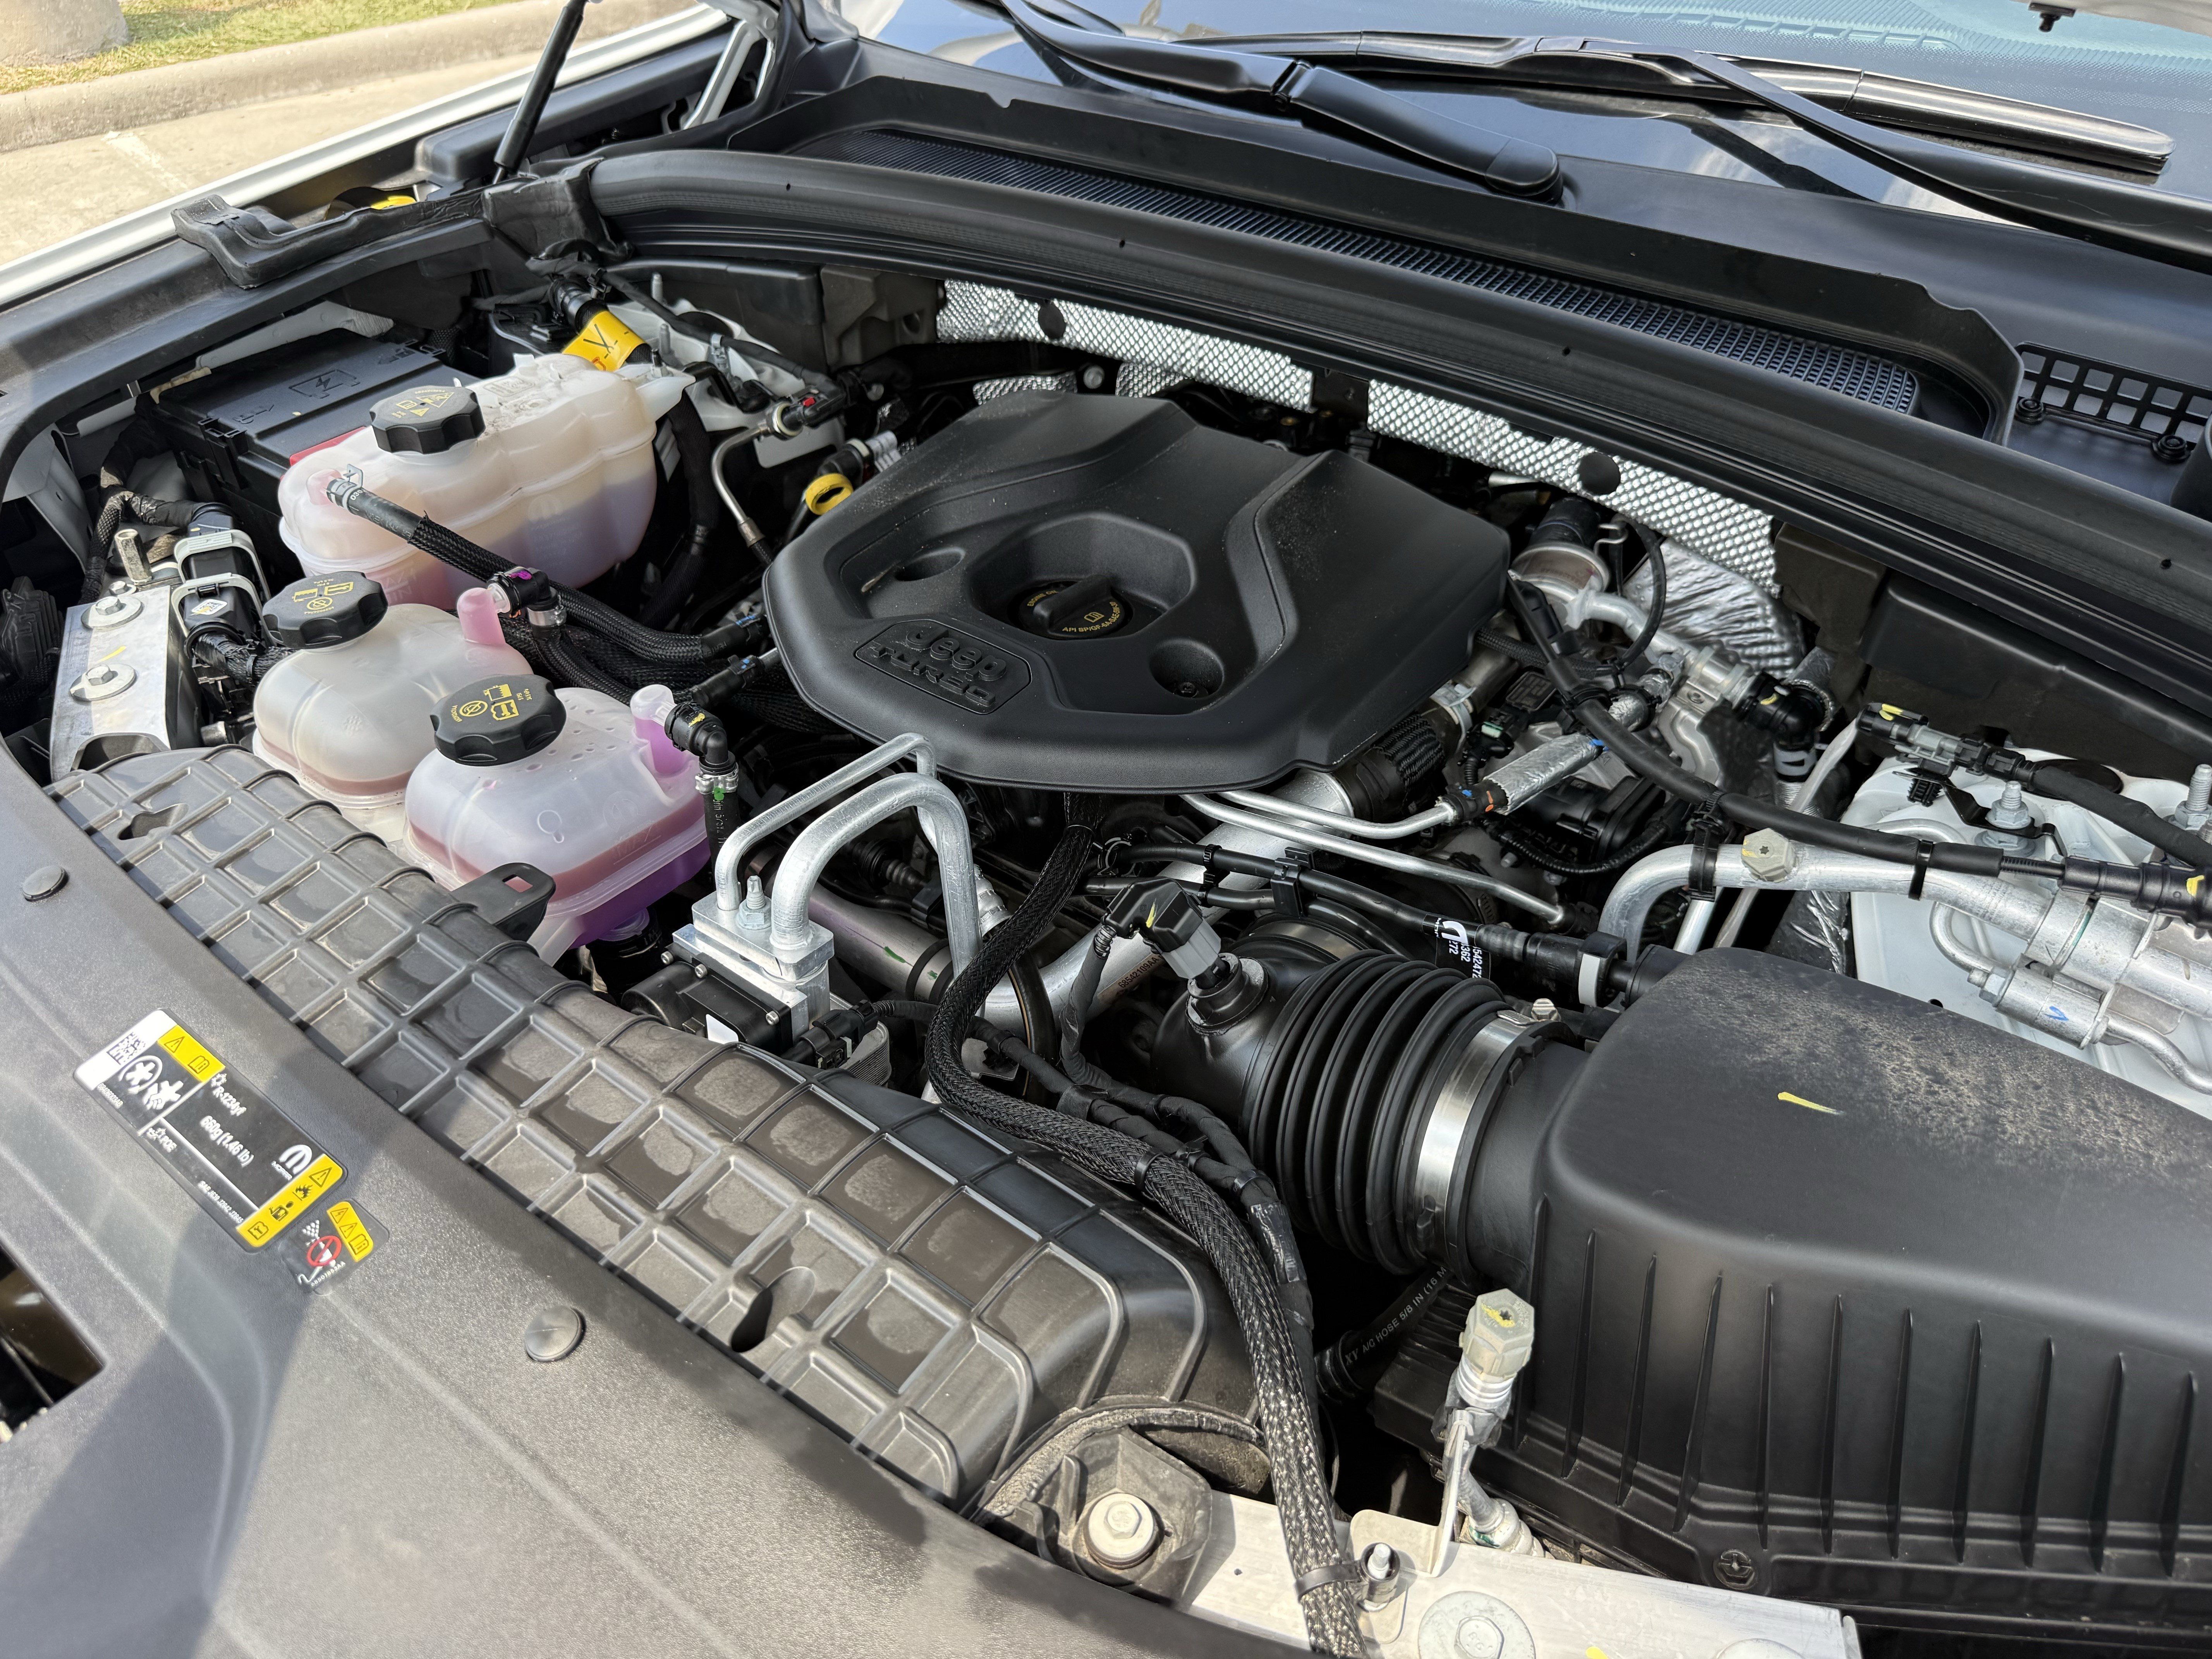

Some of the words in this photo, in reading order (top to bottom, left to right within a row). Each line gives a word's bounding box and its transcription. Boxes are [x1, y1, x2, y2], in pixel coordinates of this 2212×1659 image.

[869, 641, 996, 707] TURBO
[906, 627, 1007, 681] Jeep
[1118, 957, 1159, 988] 68542109AA
[213, 1086, 247, 1116] R-1234yf
[158, 1135, 177, 1153] POE
[199, 1115, 223, 1141] 660g
[216, 1132, 244, 1156] (1.46
[237, 1149, 254, 1168] lb)
[198, 1181, 211, 1193] SAE
[1362, 1338, 1375, 1353] A/C
[1376, 1318, 1400, 1342] HOSE
[1399, 1304, 1413, 1320] 5/8
[1412, 1293, 1424, 1306] IN
[1423, 1277, 1437, 1294] (16
